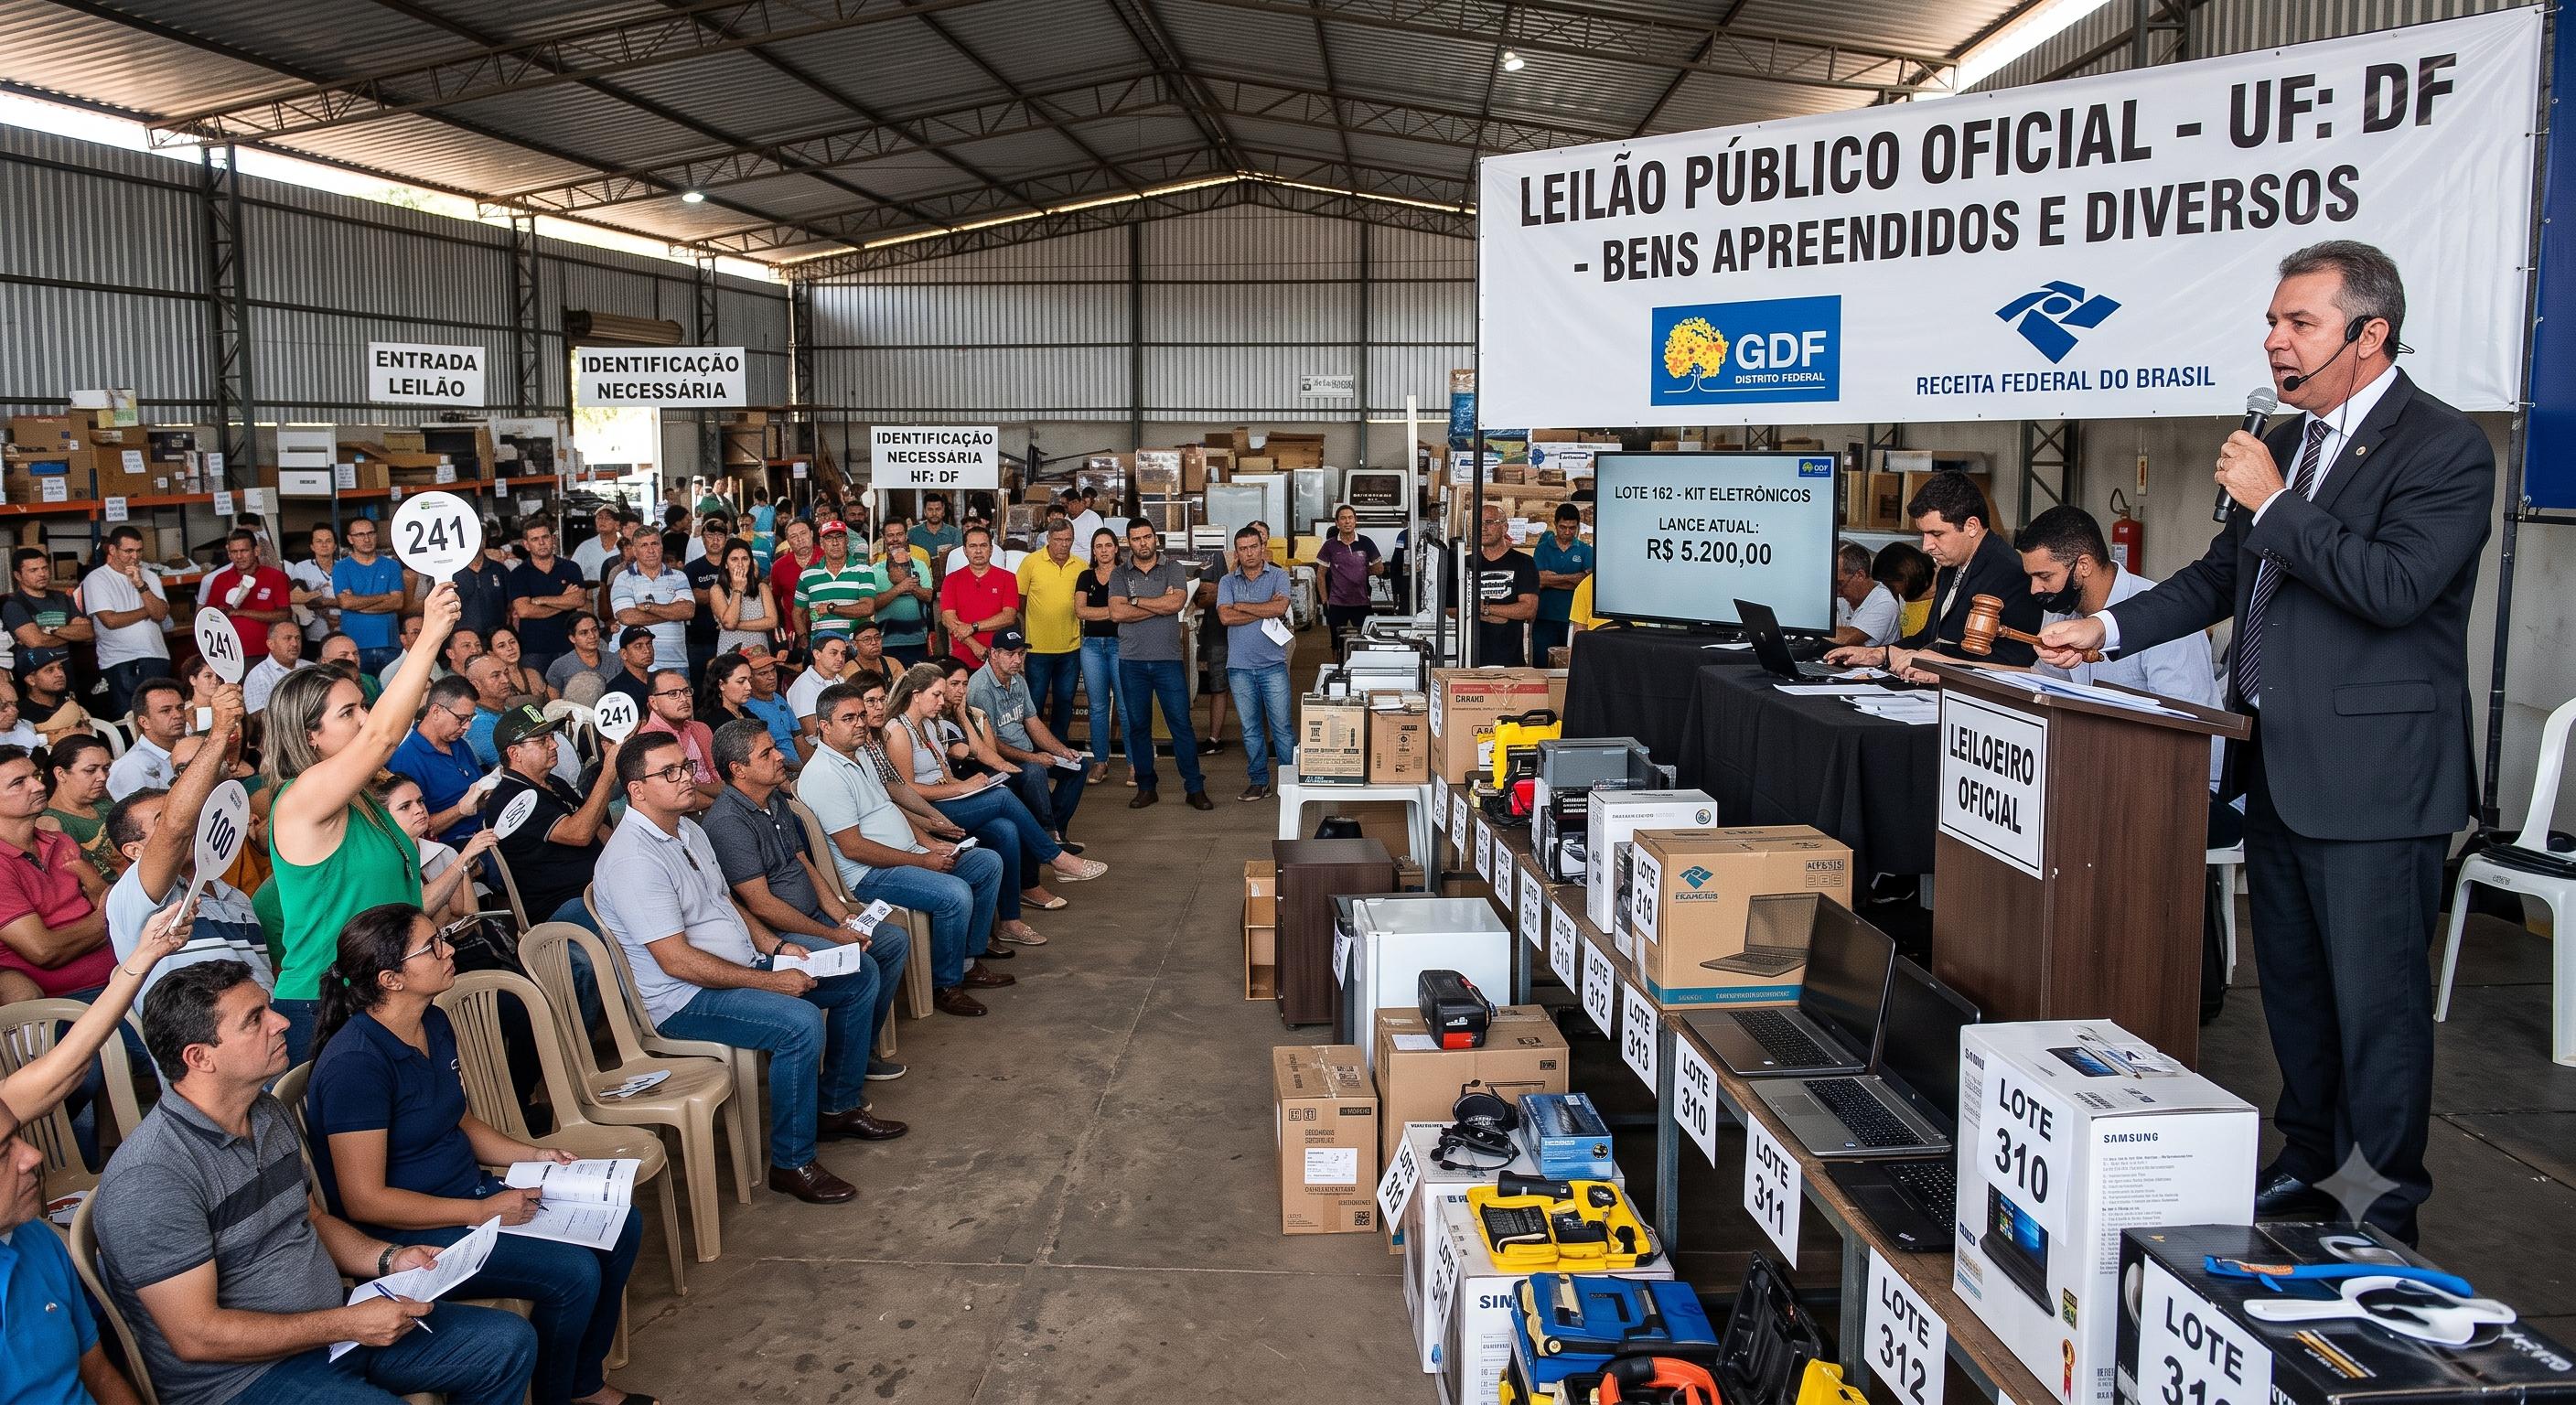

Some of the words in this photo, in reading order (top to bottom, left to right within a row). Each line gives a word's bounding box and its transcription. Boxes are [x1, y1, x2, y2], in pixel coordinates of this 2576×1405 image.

[1520, 149, 1667, 227] LEILÃO
[1685, 135, 1901, 209] PÚBLICO
[1922, 99, 2152, 184] OFICIAL
[2176, 122, 2202, 138] -
[2229, 74, 2334, 148] UF:
[2362, 53, 2457, 134] DF
[1574, 263, 1589, 273] -
[1603, 231, 1700, 283] BENS
[1712, 199, 2020, 273] APREENDIDOS
[2039, 195, 2066, 247] E
[2086, 164, 2360, 243] DIVERSOS
[376, 350, 478, 371] ENTRADA
[581, 353, 740, 378] IDENTIFICAÇÃO
[1735, 330, 1827, 370] GDF
[388, 376, 466, 397] LEILÃO
[596, 379, 728, 400] NECESSÁRIA
[1735, 373, 1779, 384] DISTRITO
[1782, 371, 1826, 383] FEDERAL
[1916, 374, 1995, 395] RECEITA
[2002, 370, 2092, 392] FEDERAL
[2100, 369, 2130, 390] DO
[2136, 366, 2216, 388] BRASIL
[876, 431, 993, 447] IDENTIFICAÇÃO
[887, 449, 983, 464] NECESSÁRIA
[939, 470, 959, 483] DF
[1615, 486, 1648, 500] LOTE
[1652, 487, 1673, 500] 162
[1684, 487, 1707, 501] KIT
[1709, 485, 1811, 503] ELETRÔNICOS
[405, 516, 465, 554] 241
[1658, 517, 1705, 531] LANCE
[1708, 519, 1760, 534] ATUAL:
[1647, 538, 1674, 563] R$
[1680, 540, 1772, 568] 5.200,00
[204, 629, 234, 661] 241
[600, 704, 632, 727] 241
[1949, 723, 2034, 786] LEILOEIRO
[1959, 776, 2022, 834] OFICIAL
[206, 808, 236, 861] 100
[1637, 856, 1655, 889] LOTE
[1524, 903, 1537, 934] 310
[1555, 915, 1571, 944] LOTE
[1589, 953, 1608, 986] LOTE
[1588, 981, 1606, 1021] 312
[1629, 998, 1650, 1035] LOTE
[1628, 1029, 1648, 1072] 313
[1683, 1052, 1709, 1098] LOTE
[1682, 1088, 1707, 1137] 310
[2000, 1078, 2053, 1142] LOTE
[2103, 1132, 2159, 1143] SAMSUNG
[1399, 1143, 1415, 1185] LOTE
[1756, 1133, 1788, 1190] LOTE
[1994, 1127, 2048, 1204] 310
[1755, 1173, 1785, 1237] 311
[1438, 1235, 1455, 1284] LOTE
[1882, 1276, 1930, 1350] LOTE
[2165, 1295, 2244, 1386] LOTE
[1879, 1323, 1927, 1405] 312
[2162, 1355, 2232, 1405] 31
